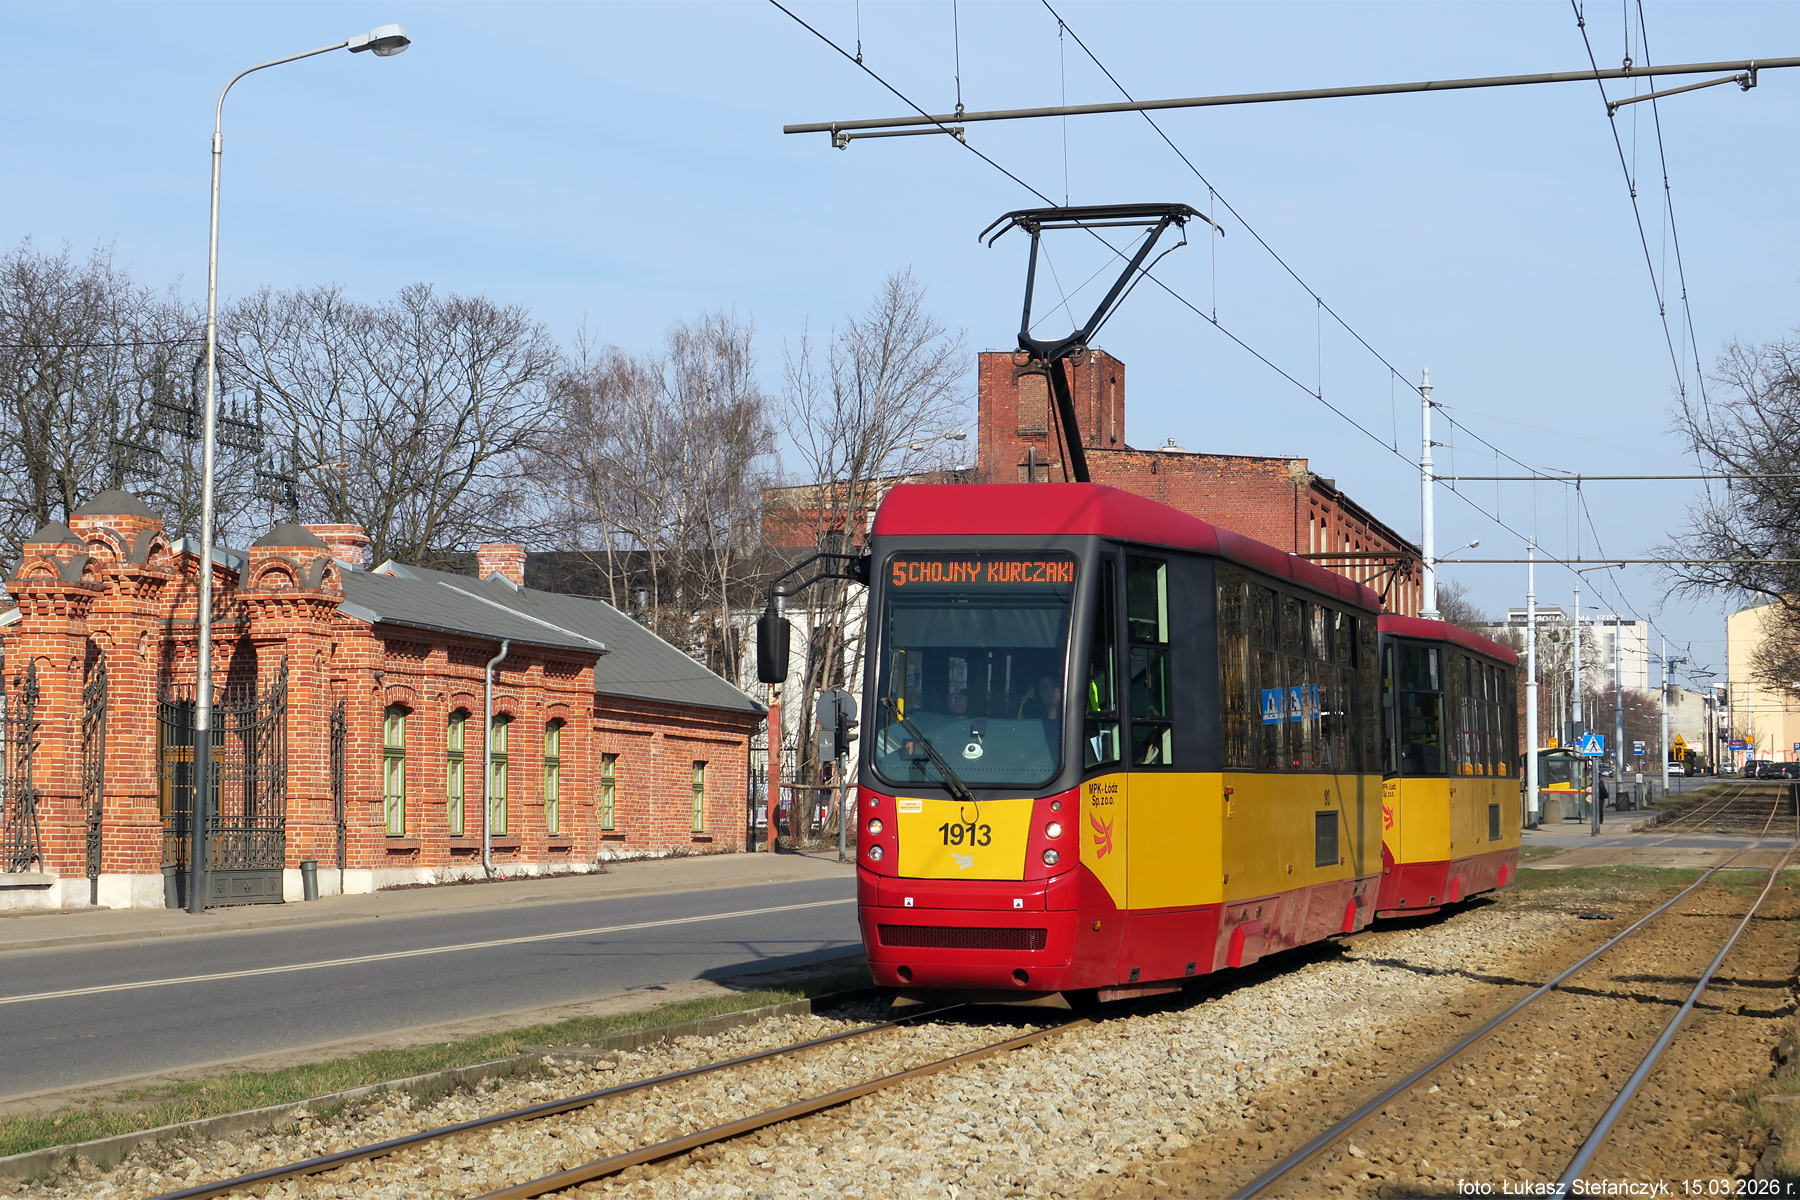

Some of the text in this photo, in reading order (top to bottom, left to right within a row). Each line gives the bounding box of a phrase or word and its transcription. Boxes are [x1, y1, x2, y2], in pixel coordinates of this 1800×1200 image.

[892, 561, 1074, 586] 5 CHOJNY KURCZAKI
[938, 822, 992, 847] 1913
